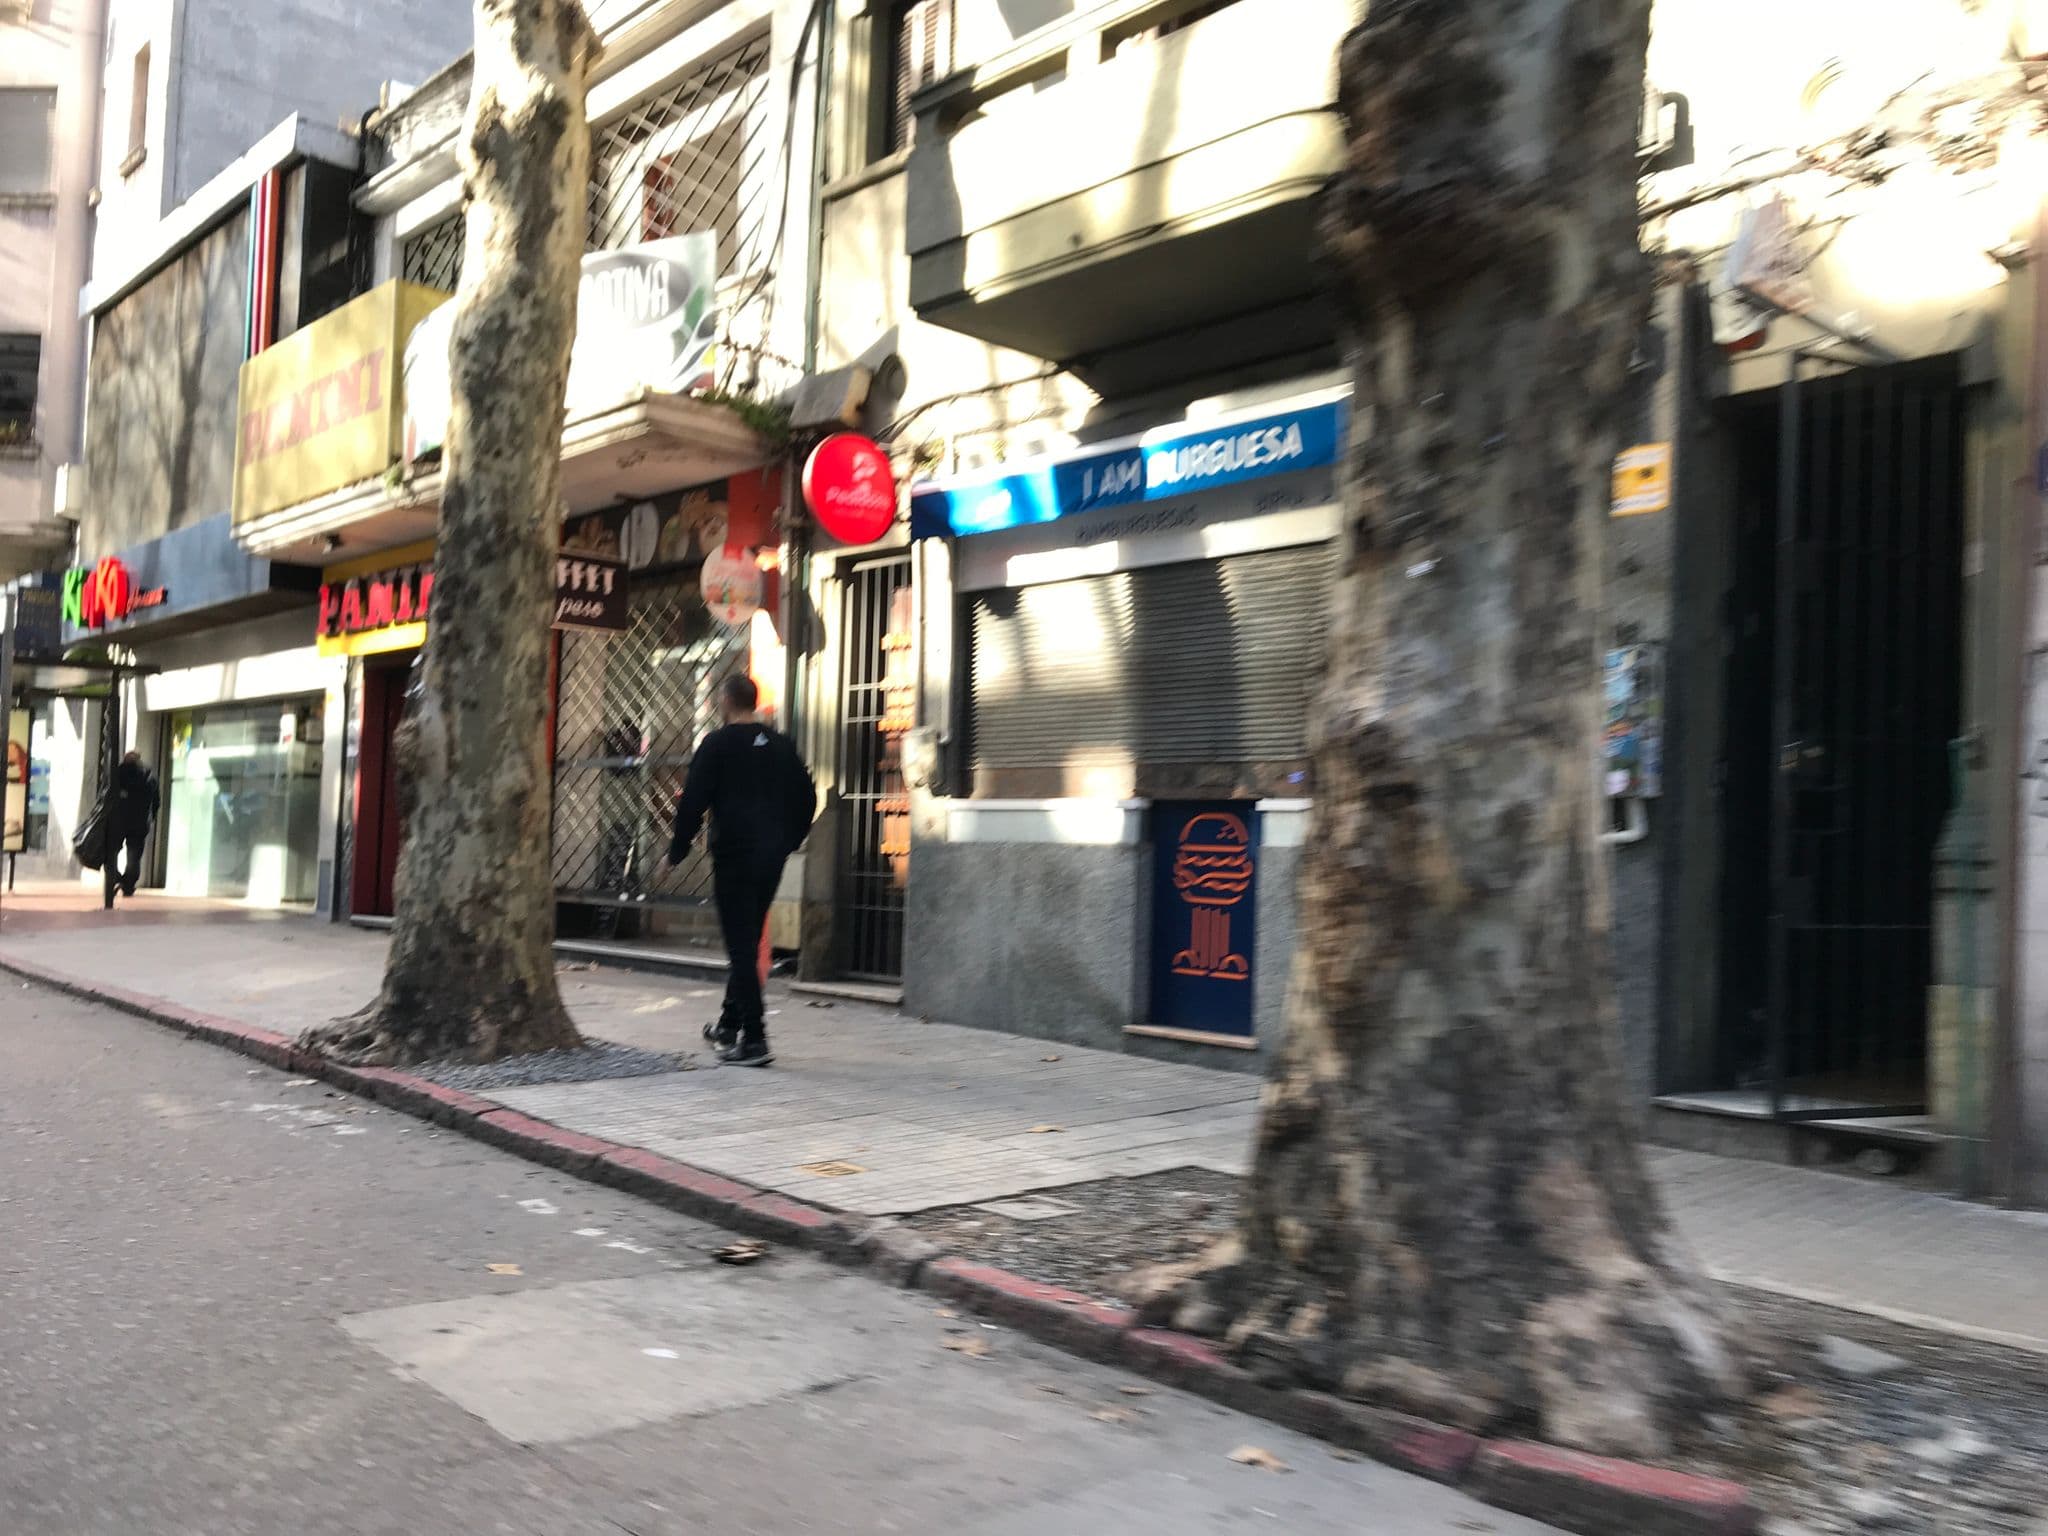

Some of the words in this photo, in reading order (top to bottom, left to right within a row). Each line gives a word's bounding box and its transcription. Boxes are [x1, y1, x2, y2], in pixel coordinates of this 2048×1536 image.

[1082, 467, 1093, 502] I
[1097, 457, 1142, 498] AM
[1145, 421, 1304, 489] BURGUESA
